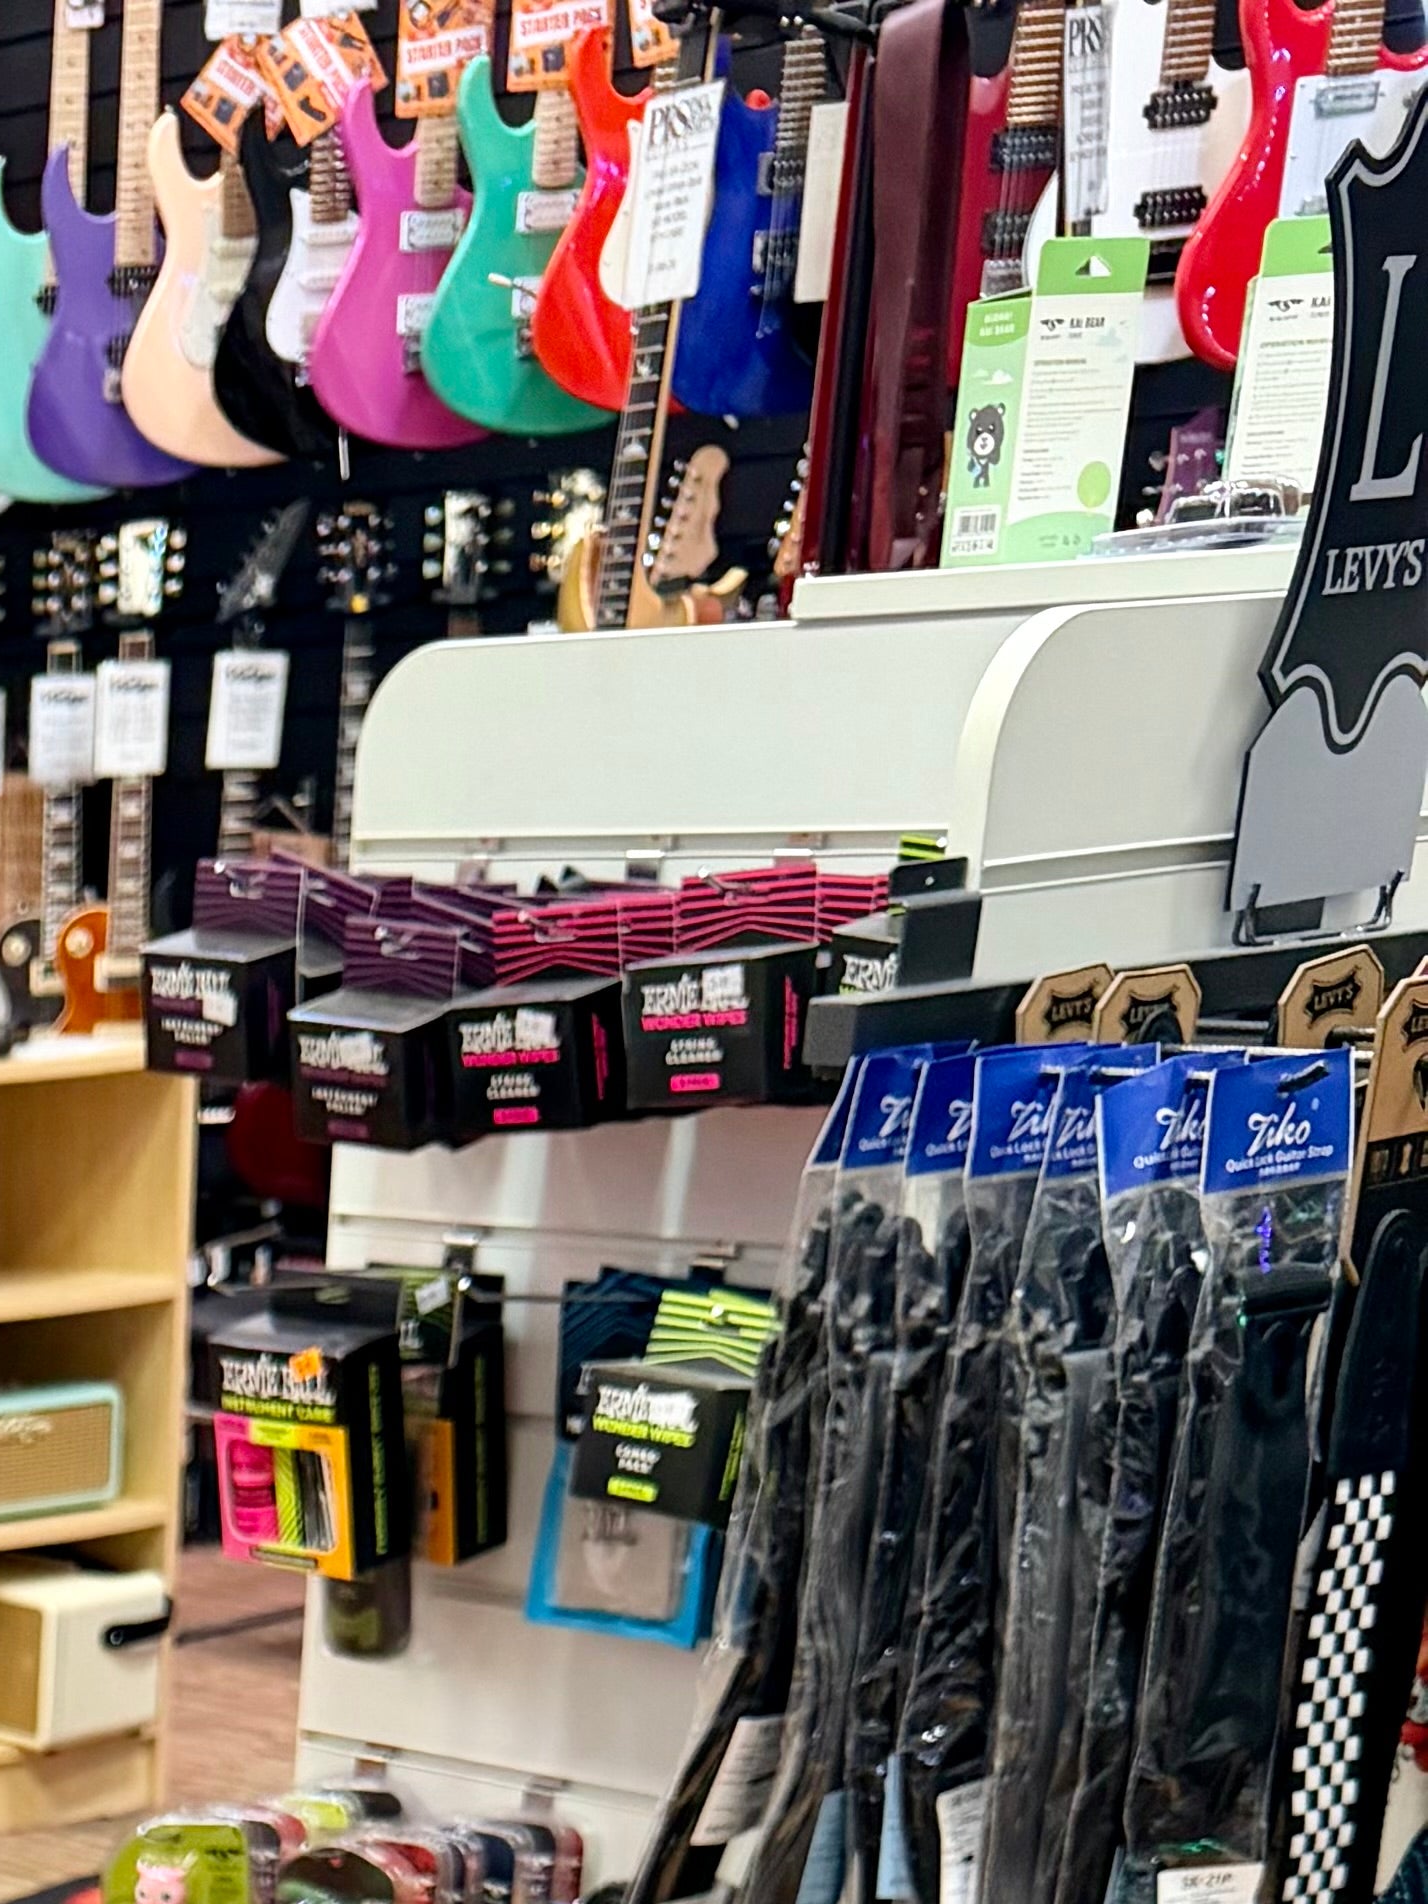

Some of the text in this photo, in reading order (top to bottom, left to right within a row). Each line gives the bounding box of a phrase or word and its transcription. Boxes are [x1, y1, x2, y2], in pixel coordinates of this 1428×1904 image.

[1349, 254, 1424, 502] L
[1321, 538, 1426, 596] LEVY'S
[843, 952, 897, 993] ERNI
[642, 973, 699, 1015] ERNIE
[458, 1011, 513, 1054] ERNIE
[641, 1014, 701, 1032] WONDER
[1247, 1101, 1312, 1157] Tiko
[1225, 1156, 1254, 1174] Quick
[1275, 1147, 1307, 1163] Guitar
[1308, 1144, 1334, 1159] Strap
[219, 1352, 284, 1401] ERNIE
[596, 1383, 650, 1422] ERNIE
[593, 1415, 649, 1440] WONDER
